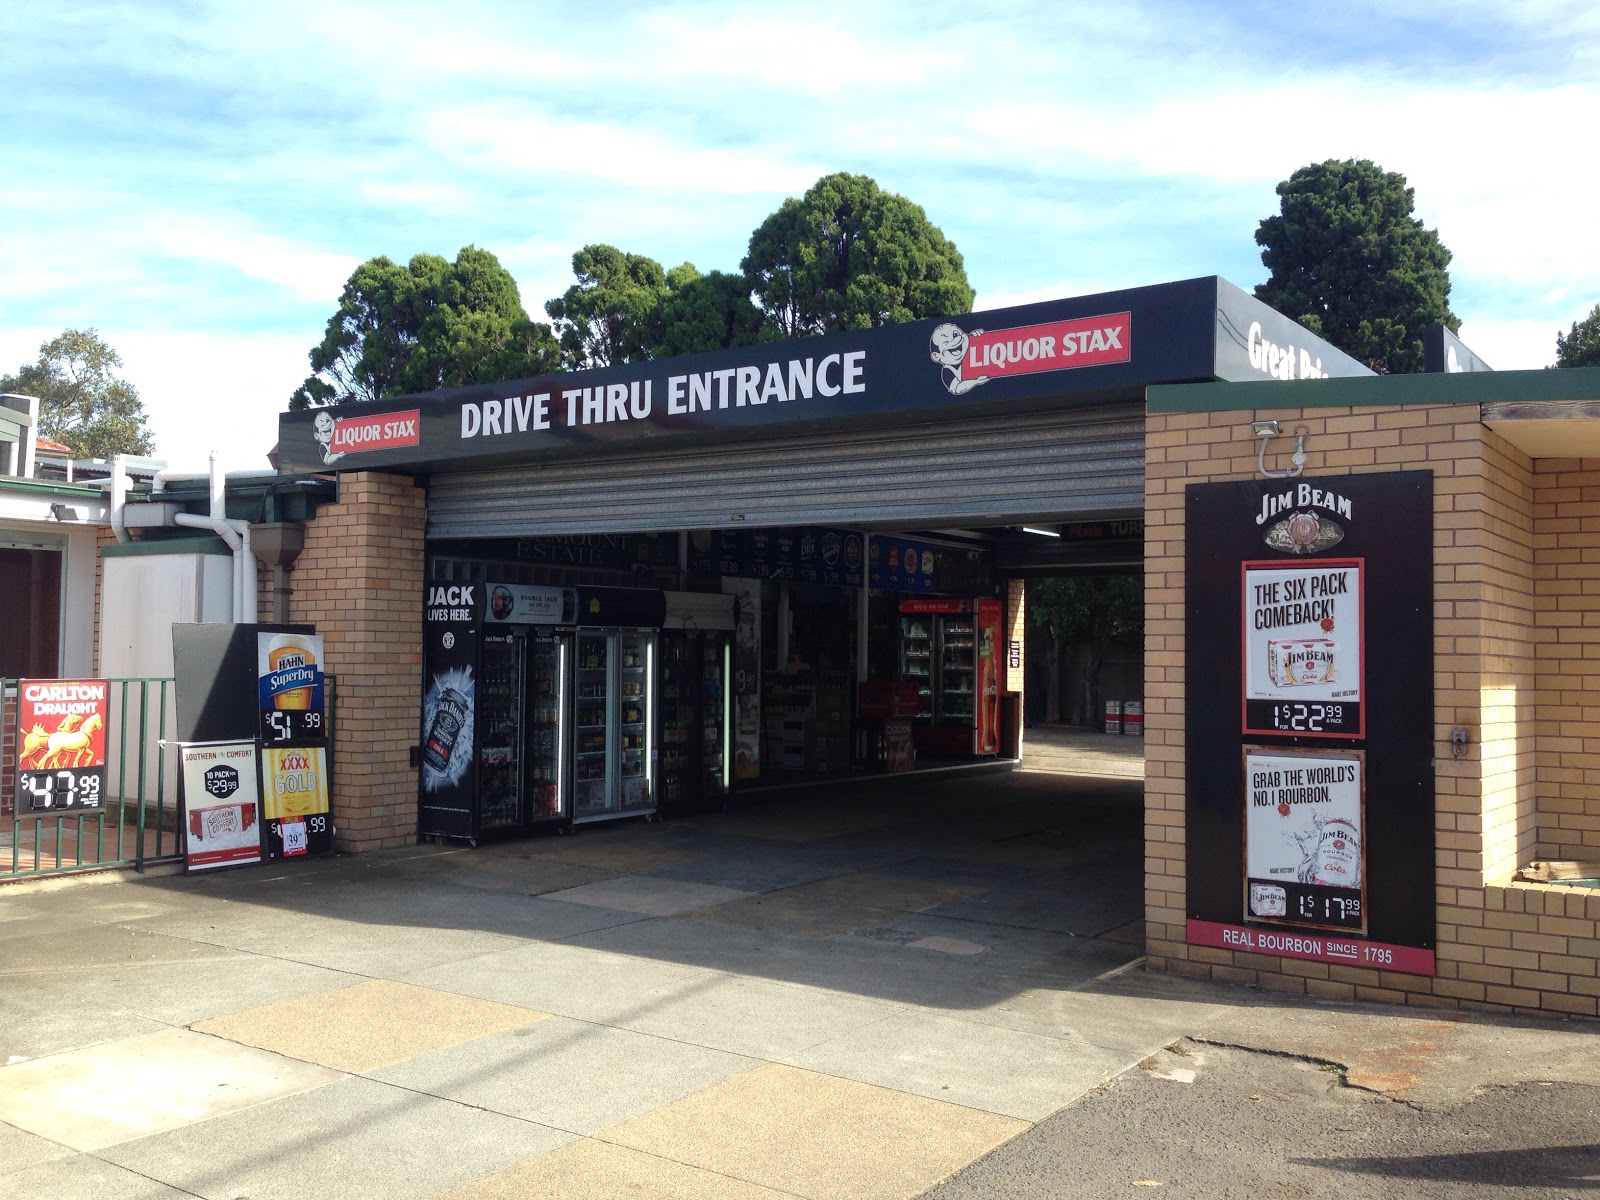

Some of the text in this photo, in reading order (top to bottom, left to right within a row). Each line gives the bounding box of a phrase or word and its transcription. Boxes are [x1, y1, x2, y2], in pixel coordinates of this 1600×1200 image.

[969, 326, 1123, 369] LIQUOR STAX
[1247, 321, 1329, 380] Great Pri
[461, 350, 866, 439] DRIVE THRU ENTRANCE
[334, 419, 416, 447] LIQUOR STAX
[1255, 483, 1353, 525] JIM BEAM
[516, 541, 603, 564] ESTATE
[426, 586, 475, 606] JACK
[1254, 571, 1348, 606] THE SIX PACK
[427, 608, 472, 621] LIVES HERE.
[1254, 598, 1336, 630] COMEBACK!
[278, 656, 304, 671] HAHN
[1284, 649, 1334, 668] JIM BEAM
[270, 669, 314, 690] SuperDry
[25, 686, 105, 702] CARLTON
[33, 702, 99, 716] DRAUGHT
[185, 749, 253, 762] SOUTHERN COMFORT
[280, 756, 310, 771] XXXX
[206, 771, 214, 779] 10
[214, 770, 230, 779] PACK
[274, 772, 317, 796] GOLD
[1253, 765, 1355, 789] GRAB THE WORLD'S
[1253, 785, 1332, 807] NO.1 BOURBON.
[1322, 849, 1353, 860] BOURBON
[1324, 863, 1348, 875] Cola
[1223, 929, 1392, 964] REAL BOURBON SINCE 1795
